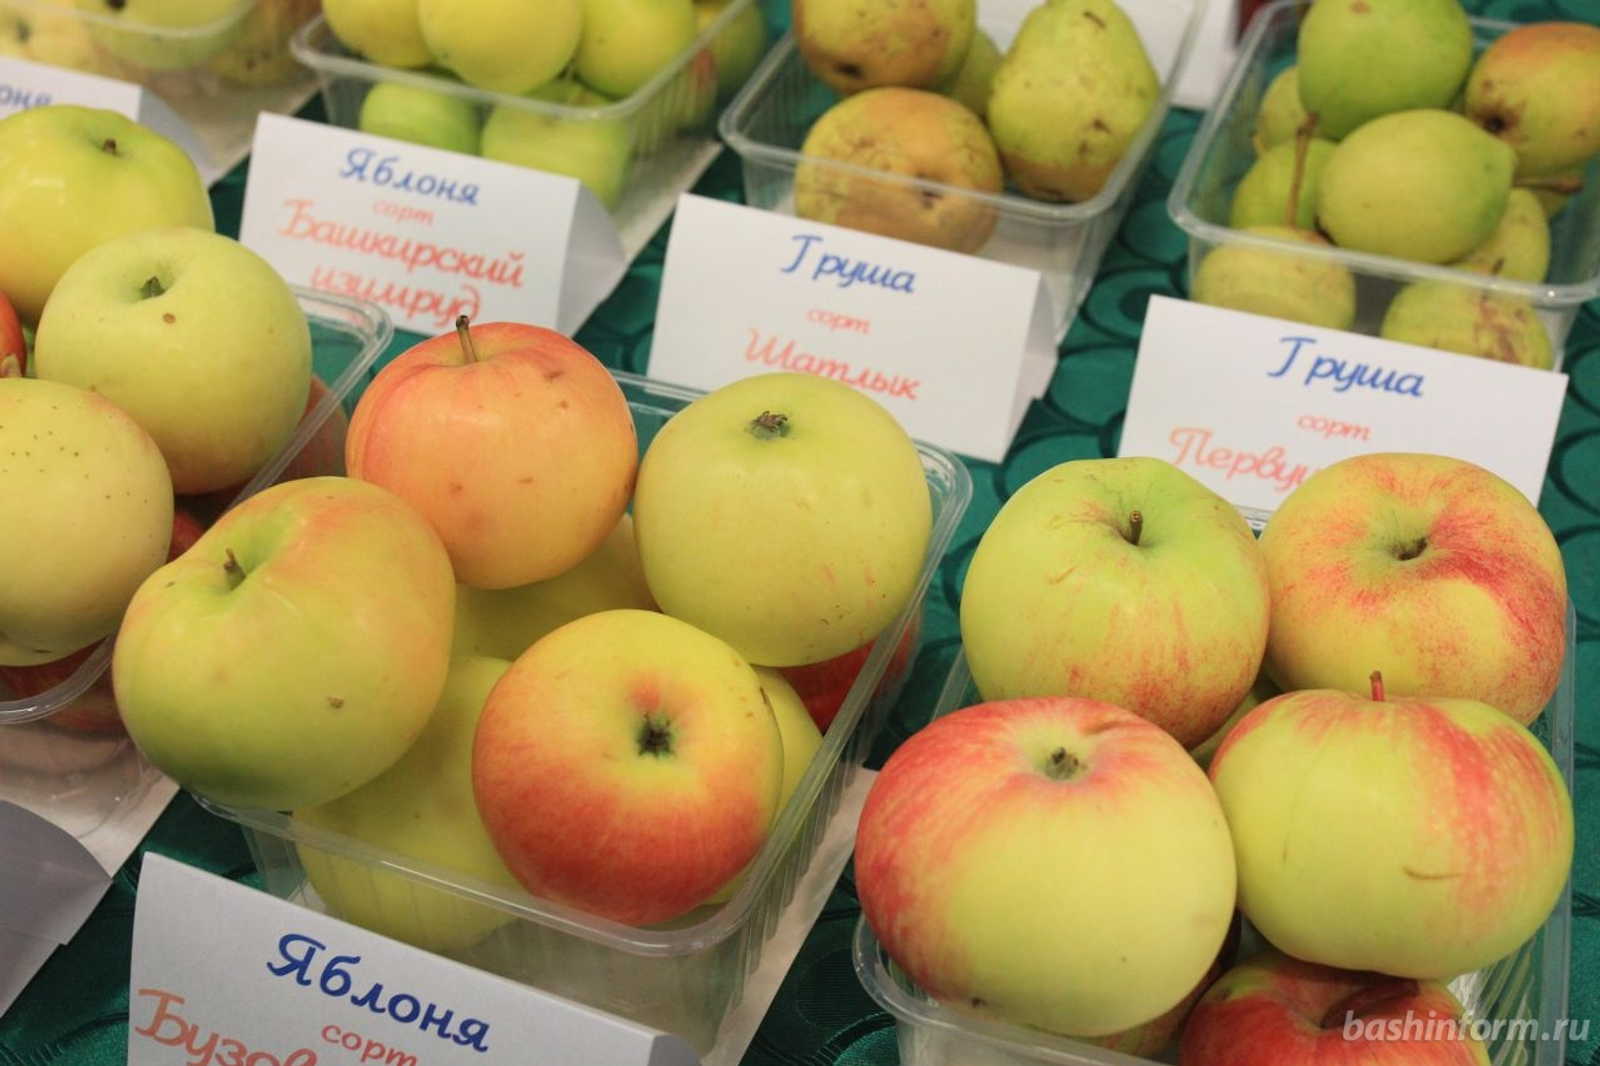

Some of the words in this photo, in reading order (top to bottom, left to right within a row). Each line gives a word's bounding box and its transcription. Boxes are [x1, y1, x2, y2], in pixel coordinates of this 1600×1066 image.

[339, 147, 480, 206] Яблоня
[371, 199, 436, 227] сорт
[281, 199, 525, 288] Башкирский
[780, 234, 917, 294] Груша
[311, 264, 482, 328] изумруд
[805, 307, 871, 335] сорт
[744, 328, 921, 401] Шатлык
[1267, 336, 1425, 397] Груша
[1296, 412, 1372, 442] сорт
[266, 933, 491, 1053] Яблоня
[321, 1024, 418, 1066] сорт
